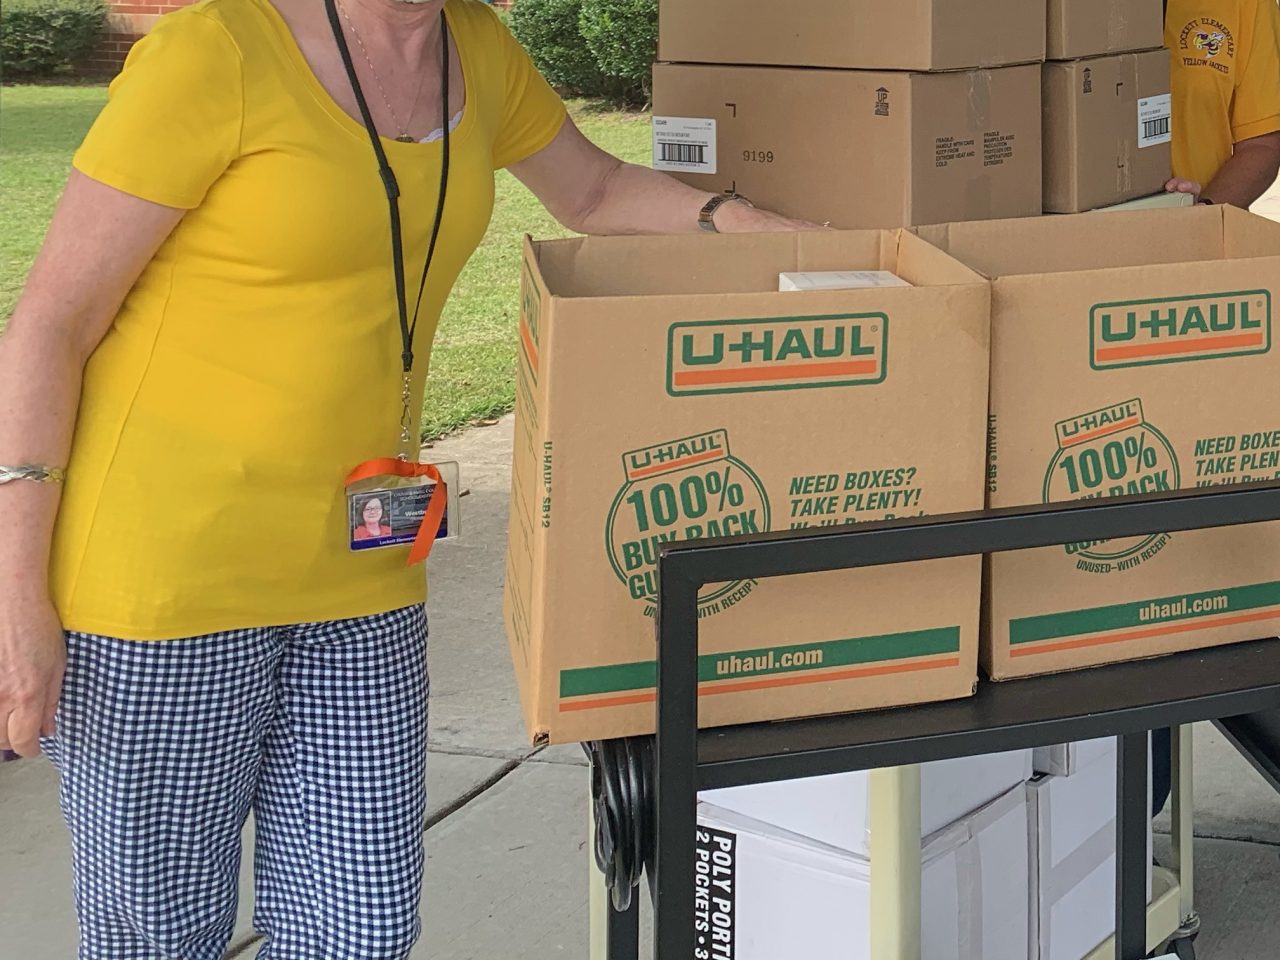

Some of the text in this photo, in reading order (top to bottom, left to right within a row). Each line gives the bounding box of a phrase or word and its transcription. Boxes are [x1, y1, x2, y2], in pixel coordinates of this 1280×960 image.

[1180, 18, 1234, 58] LOCKETT ELEMENTARY
[1183, 57, 1229, 73] YELLOW JACKETS
[878, 91, 888, 103] UP
[743, 150, 774, 163] 9199
[1101, 301, 1262, 342] U-HAUL
[681, 324, 875, 366] U-HAUL
[1062, 405, 1137, 437] U-HAUL
[631, 437, 721, 468] U-HAUL
[1194, 436, 1235, 456] NEED
[1060, 432, 1157, 494] 100%
[1196, 456, 1236, 476] TAKE
[789, 467, 916, 495] NEED BOXES?
[541, 497, 551, 529] SB12
[627, 466, 743, 532] 100%
[790, 488, 921, 517] TAKE PLENTY!
[722, 580, 758, 608] RECEIPT
[1139, 592, 1228, 621] uhaul.com
[716, 648, 823, 675] uhaul.com
[696, 831, 709, 843] 2
[713, 836, 732, 893] POLY
[696, 848, 709, 932] POCKETS
